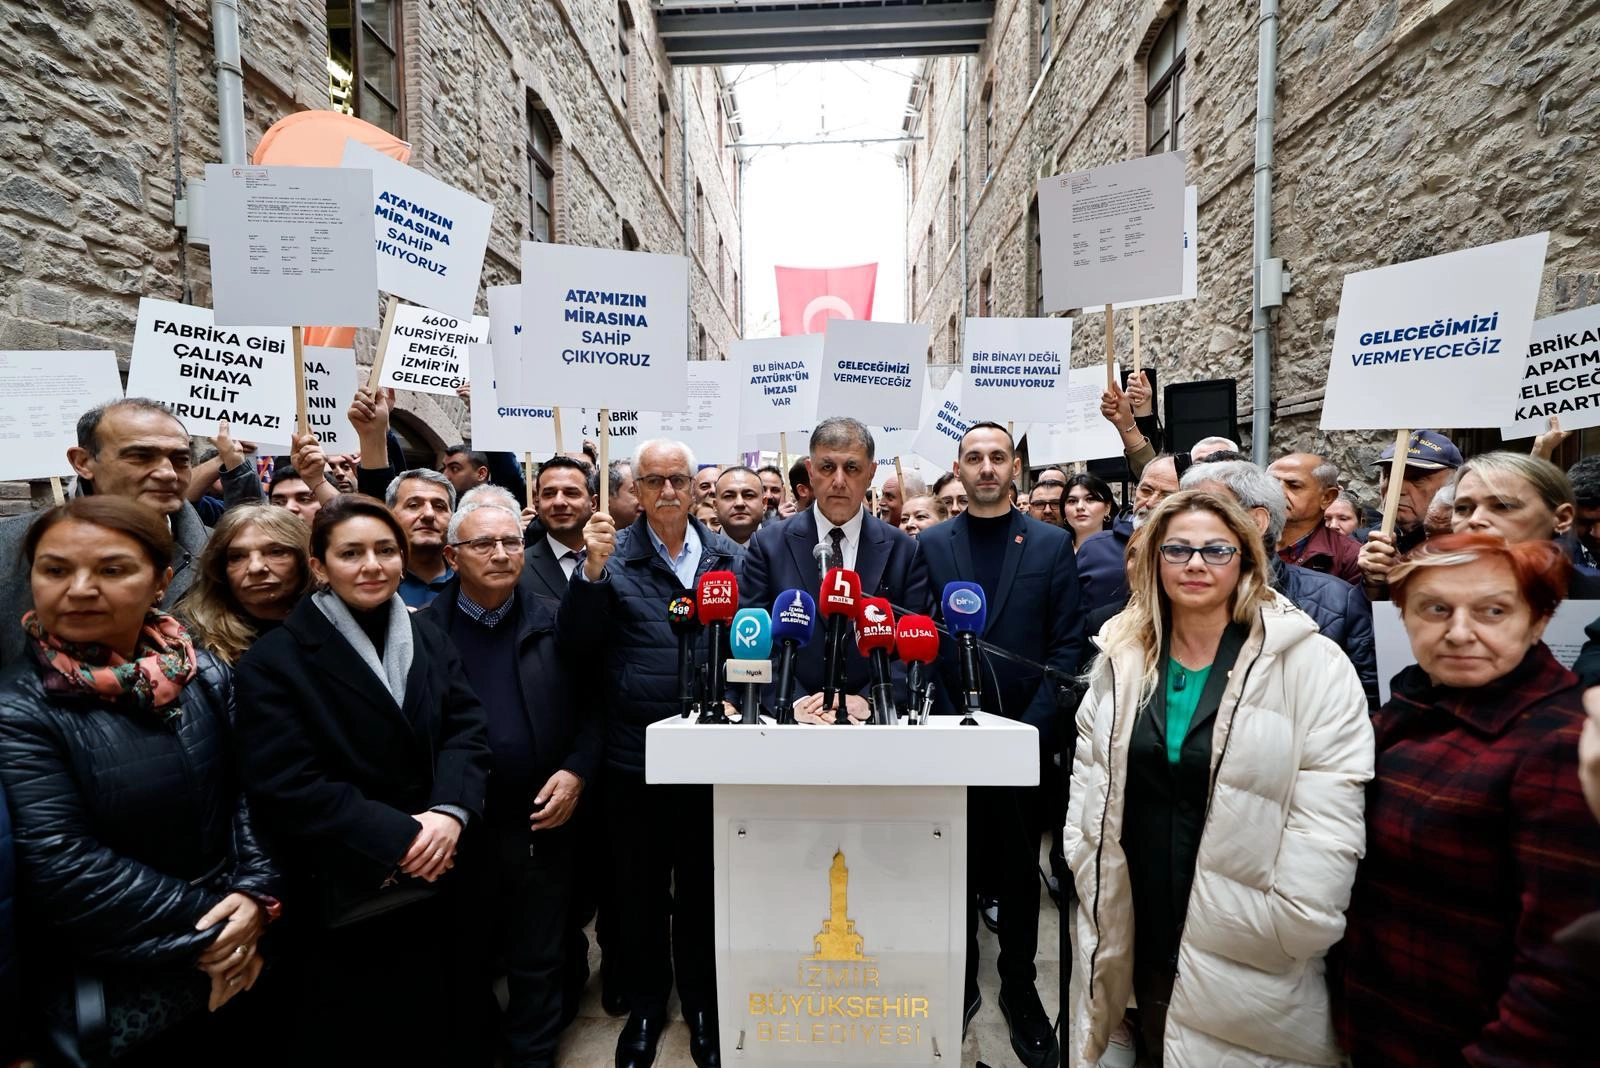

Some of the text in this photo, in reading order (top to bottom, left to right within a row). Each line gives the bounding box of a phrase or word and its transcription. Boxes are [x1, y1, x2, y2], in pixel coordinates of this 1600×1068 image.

[379, 191, 453, 230] ATA'MIZIN
[374, 204, 450, 245] MİRASINA
[387, 227, 433, 252] SAHİP
[375, 240, 447, 276] IKIYORUZ
[565, 289, 646, 308] ATA'MIZIN
[422, 315, 458, 328] 4600
[564, 306, 648, 327] MİRASINA
[153, 319, 286, 354] FABRİKA GİBİ
[582, 329, 631, 345] SAHİP
[1359, 312, 1499, 346] GELECEĞİMİZİ
[173, 343, 263, 369] ÇALIŞAN
[408, 342, 457, 359] EMEĞİ,
[562, 349, 650, 367] ÇIKIYORUZ
[972, 350, 1061, 362] BİR BİNAYI DEĞİL
[1351, 337, 1502, 366] VERMEYECEĞİZ
[401, 354, 459, 373] İZMİR'İN
[753, 360, 805, 373] BU BİNADA
[838, 360, 910, 375] GELECEĞİMİZİ
[970, 363, 1061, 375] BİNLERCE HAYALİ
[1522, 350, 1600, 380] APATM
[180, 363, 252, 387] BİNAYA
[750, 372, 809, 385] ATATÜRK'ÜN
[833, 373, 912, 388] VERMEYECEĞİZ
[975, 378, 1055, 388] SAVUNUYORUZ
[189, 384, 239, 403] KİLİT
[764, 385, 797, 396] İMZASI
[772, 397, 791, 407] VAR
[944, 400, 959, 414] BİR
[497, 407, 555, 418] ÇIKIYORU
[863, 623, 892, 633] anka
[900, 628, 934, 638] ULUSAL
[797, 964, 880, 989] İZMİR
